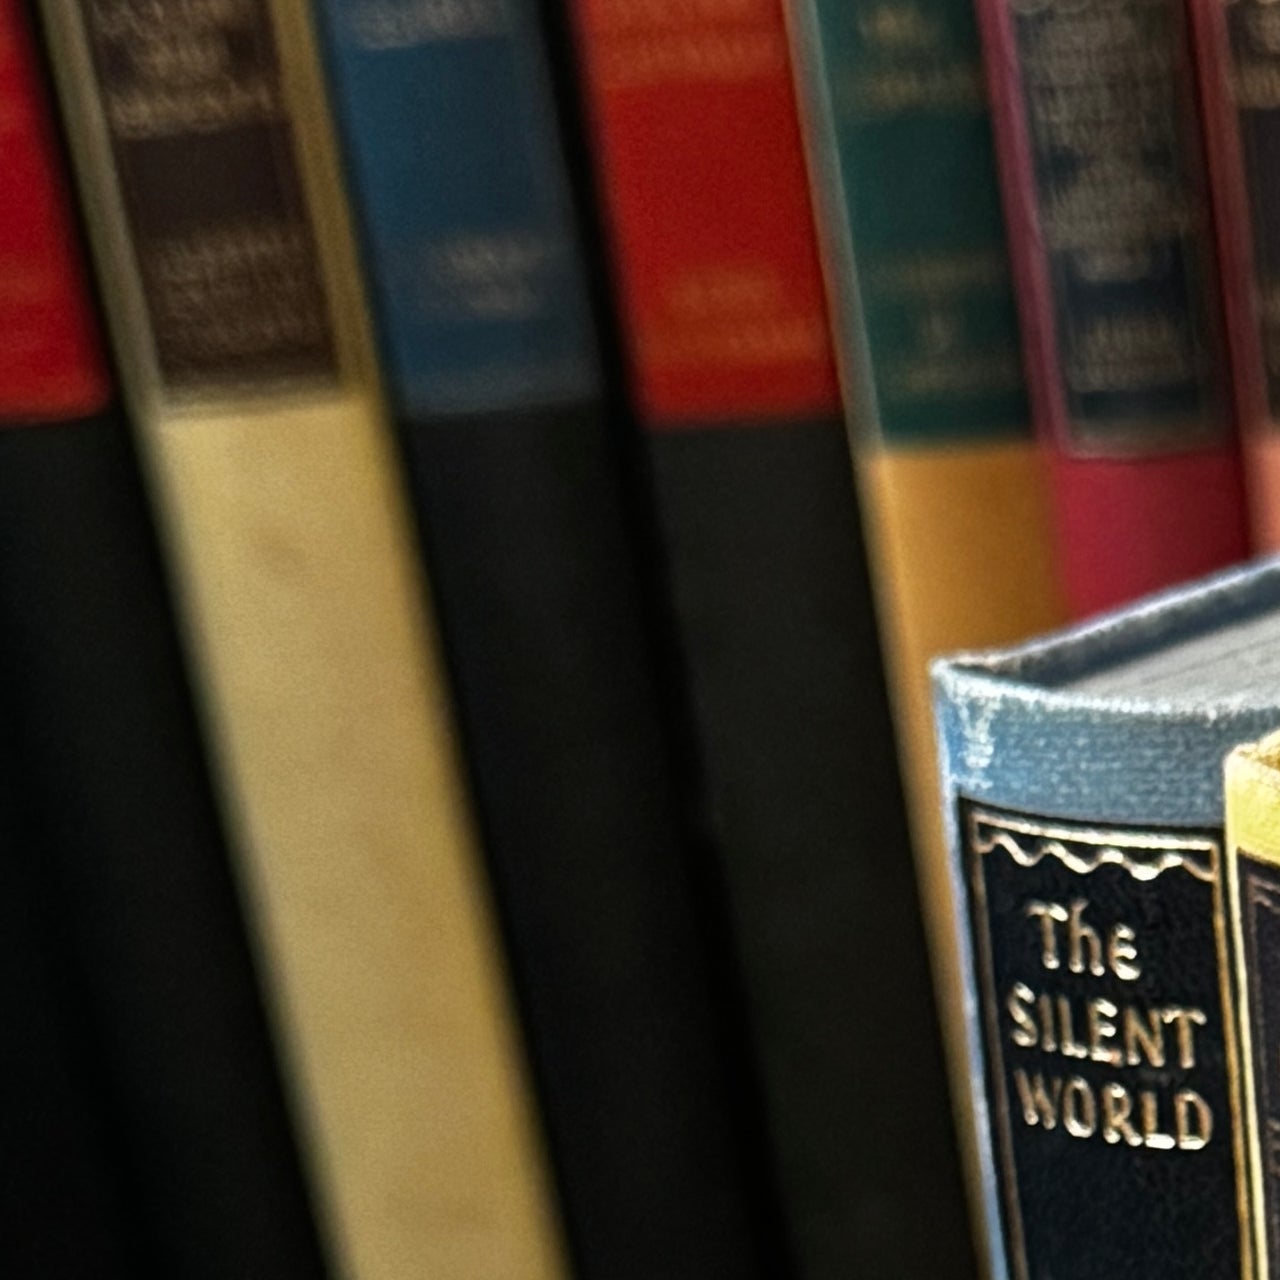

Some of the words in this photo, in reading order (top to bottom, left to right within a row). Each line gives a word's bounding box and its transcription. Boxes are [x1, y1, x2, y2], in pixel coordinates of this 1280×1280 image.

[1026, 899, 1142, 981] The
[1008, 981, 1208, 1069] SILENT
[1013, 1068, 1213, 1150] WORLD
